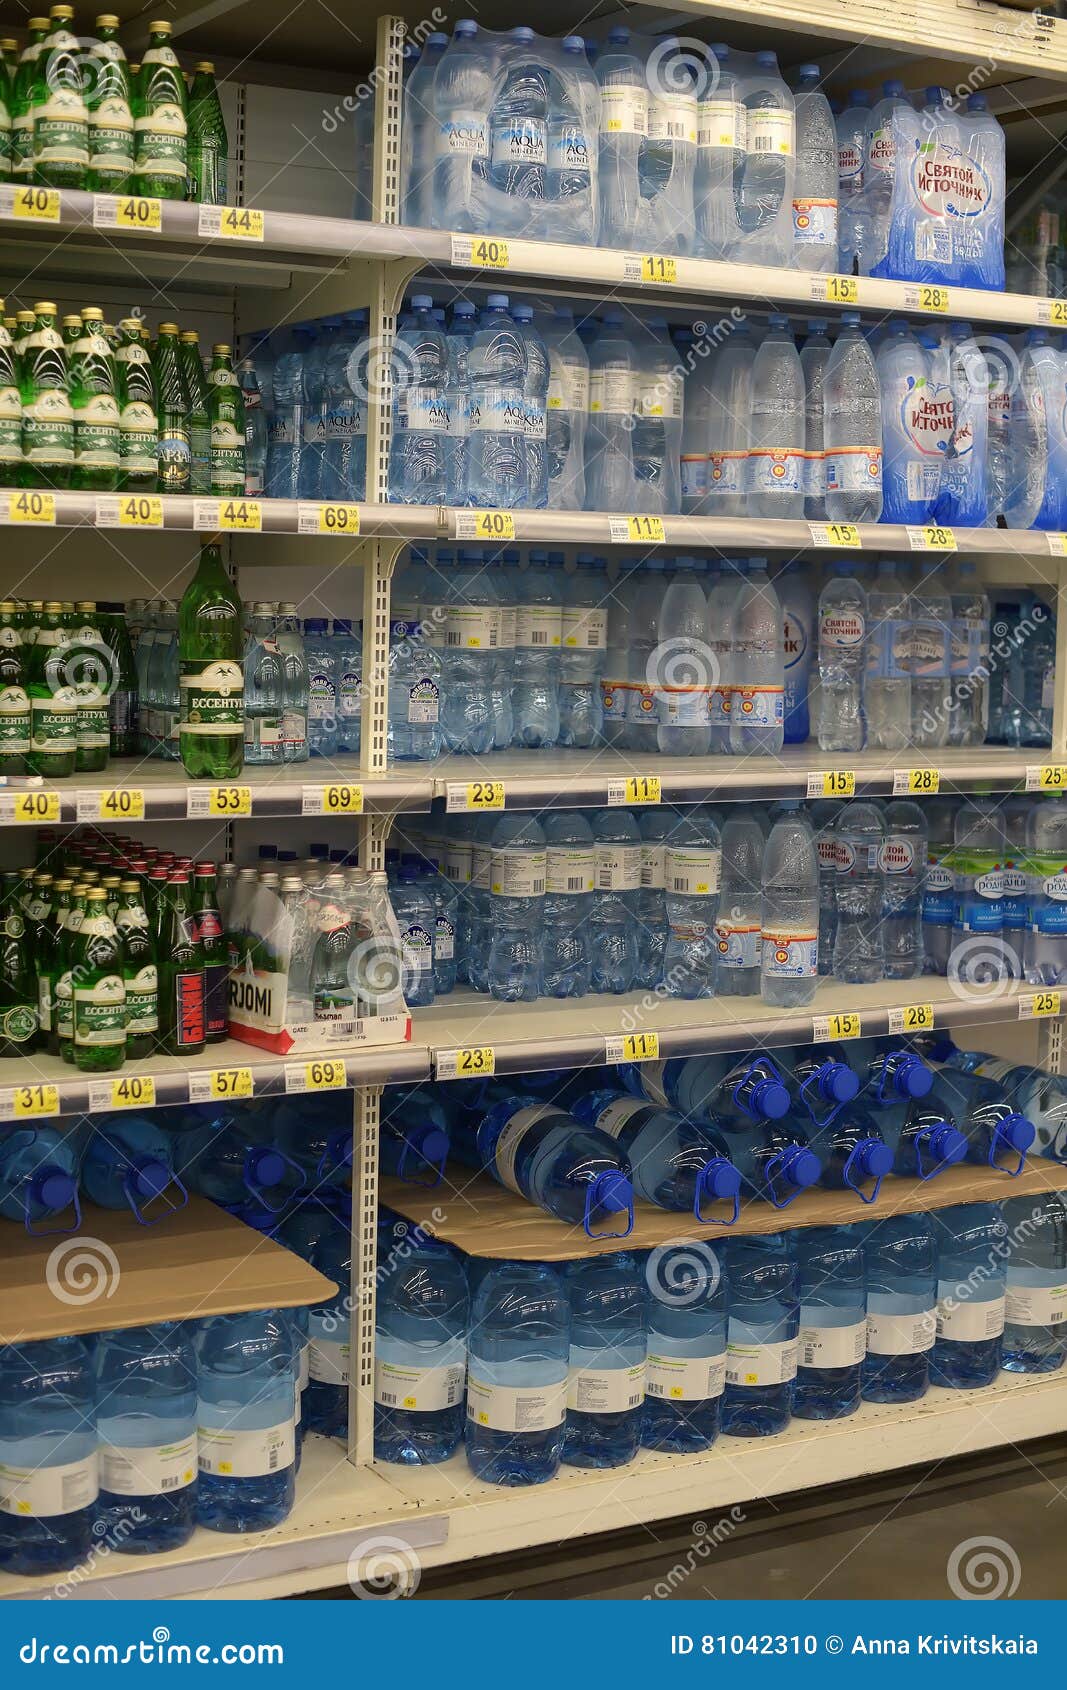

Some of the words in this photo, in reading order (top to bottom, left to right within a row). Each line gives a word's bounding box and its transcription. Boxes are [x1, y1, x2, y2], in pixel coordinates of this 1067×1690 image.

[22, 188, 48, 211] 40
[124, 199, 149, 221] 40
[226, 209, 251, 230] 44
[476, 241, 499, 262] 40
[647, 257, 665, 277] 11
[830, 278, 849, 297] 15
[923, 288, 940, 307] 28
[16, 493, 42, 514] 40
[125, 499, 150, 519] 40
[224, 502, 249, 523] 44
[325, 508, 347, 528] 69
[482, 514, 503, 533] 40
[633, 517, 651, 535] 11
[831, 526, 851, 541] 15
[927, 529, 947, 544] 28
[829, 772, 846, 789] 15
[914, 771, 931, 788] 28
[1045, 768, 1061, 784] 25
[328, 787, 350, 807] 69
[472, 783, 494, 803] 23
[630, 778, 648, 796] 11
[23, 794, 48, 815] 40
[106, 791, 131, 812] 40
[217, 788, 240, 809] 53
[228, 978, 272, 1017] RJOMI
[1037, 994, 1053, 1011] 25
[834, 1015, 851, 1033] 15
[908, 1008, 925, 1025] 28
[628, 1035, 646, 1054] 11
[462, 1049, 484, 1069] 23
[216, 1071, 239, 1092] 57
[312, 1063, 334, 1084] 69
[21, 1086, 44, 1108] 31
[118, 1078, 142, 1099] 40
